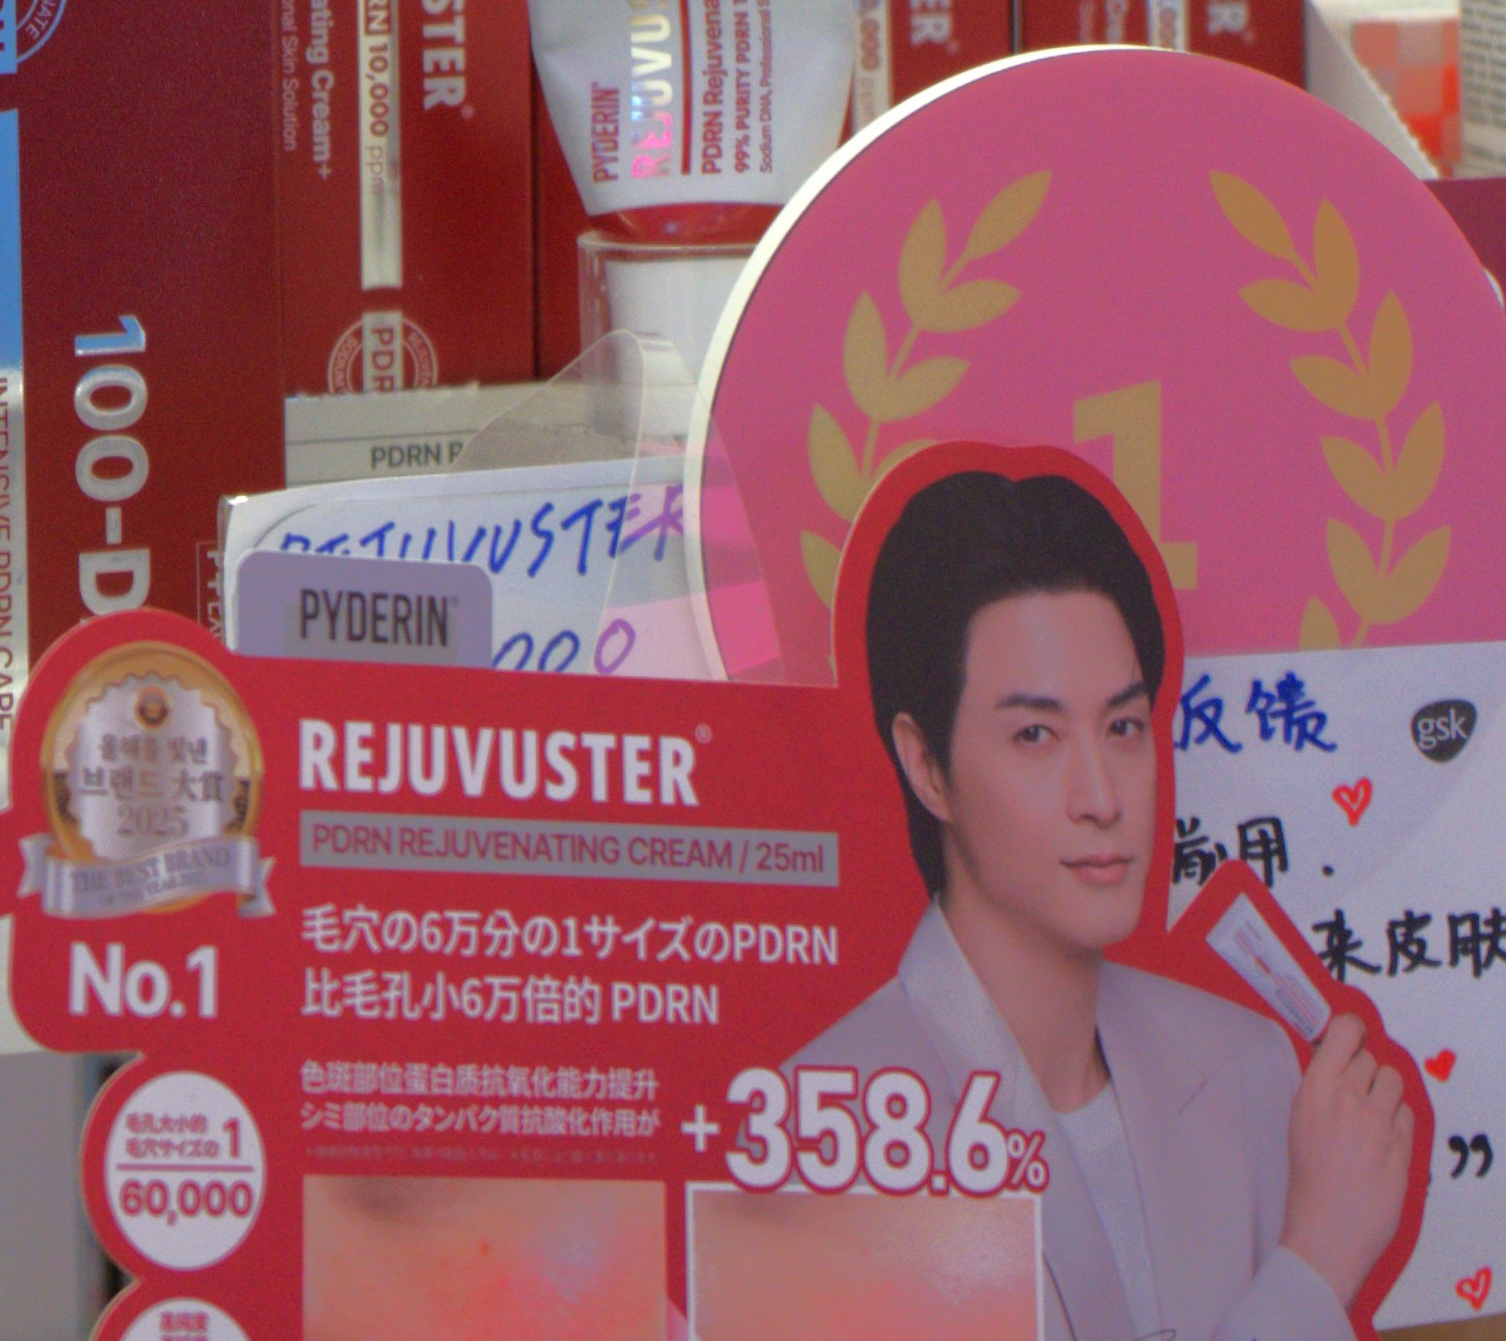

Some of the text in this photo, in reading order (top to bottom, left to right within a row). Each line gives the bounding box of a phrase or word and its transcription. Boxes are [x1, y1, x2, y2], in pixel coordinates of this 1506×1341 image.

[733, 11, 751, 65] PDRN
[366, 42, 389, 138] 10,000
[734, 67, 751, 129] PURITY
[590, 80, 621, 184] PYDERIN
[701, 111, 723, 176] PDRN
[734, 133, 751, 175] 99%
[759, 127, 773, 174] Sodium
[369, 326, 397, 392] PDR
[74, 314, 152, 623] 100-D
[369, 441, 443, 470] PDRN
[1072, 378, 1199, 591] 1
[298, 587, 451, 648] PYDERIN
[1415, 709, 1472, 754] gsk
[78, 766, 164, 802] 브랜드
[297, 718, 700, 806] REJUVUSTER
[116, 804, 189, 838] 2025
[310, 823, 826, 875] PDRN REJUVENATING CREAM / 25ml
[300, 902, 840, 967] 毛穴の6万分の1サイズのPDRN
[67, 940, 220, 1018] No.1
[300, 967, 721, 1026] 比毛孔小6万倍的 PDRN
[300, 1059, 661, 1103] 色斑部位蛋白质抗氧化能力提升
[222, 1116, 242, 1160] 1
[681, 1064, 1049, 1196] +358.6%
[118, 1177, 255, 1228] 60,000
